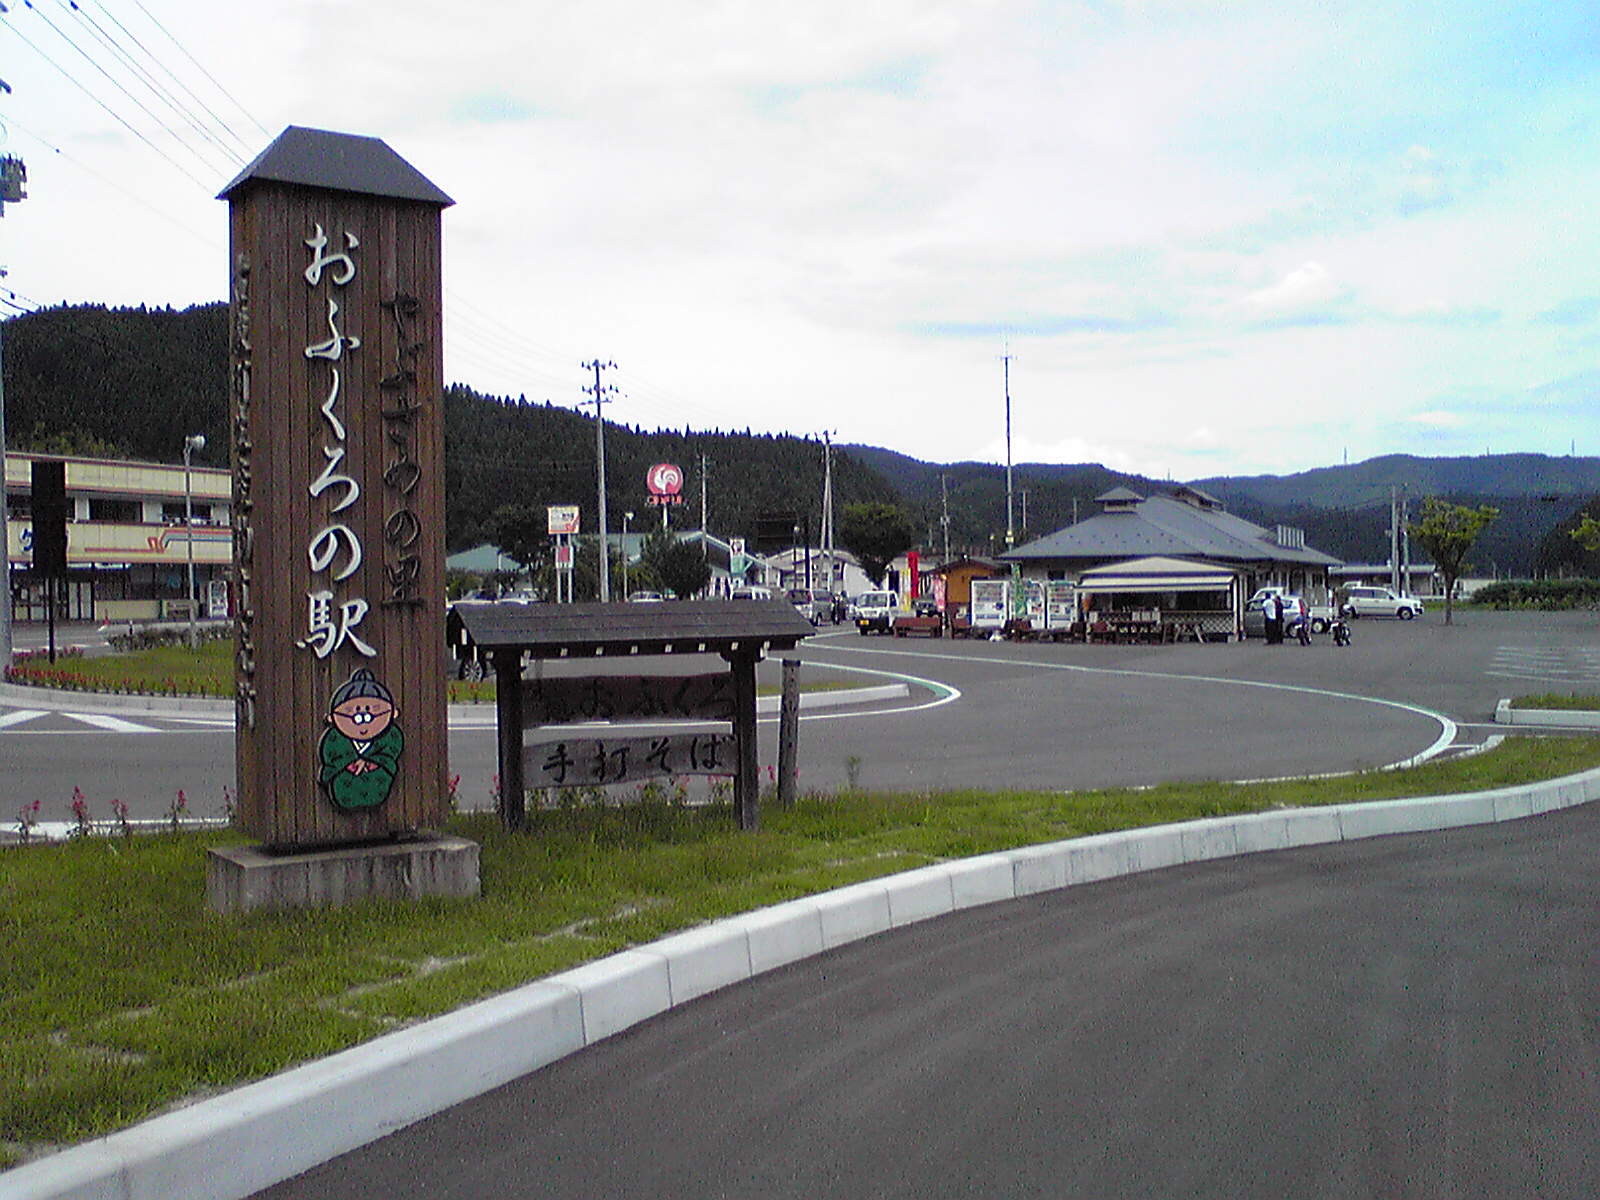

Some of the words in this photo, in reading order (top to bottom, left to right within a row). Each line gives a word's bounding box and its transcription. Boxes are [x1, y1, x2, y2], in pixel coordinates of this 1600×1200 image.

[296, 222, 377, 660] おふくろの駅
[542, 734, 736, 784] 手打そば
